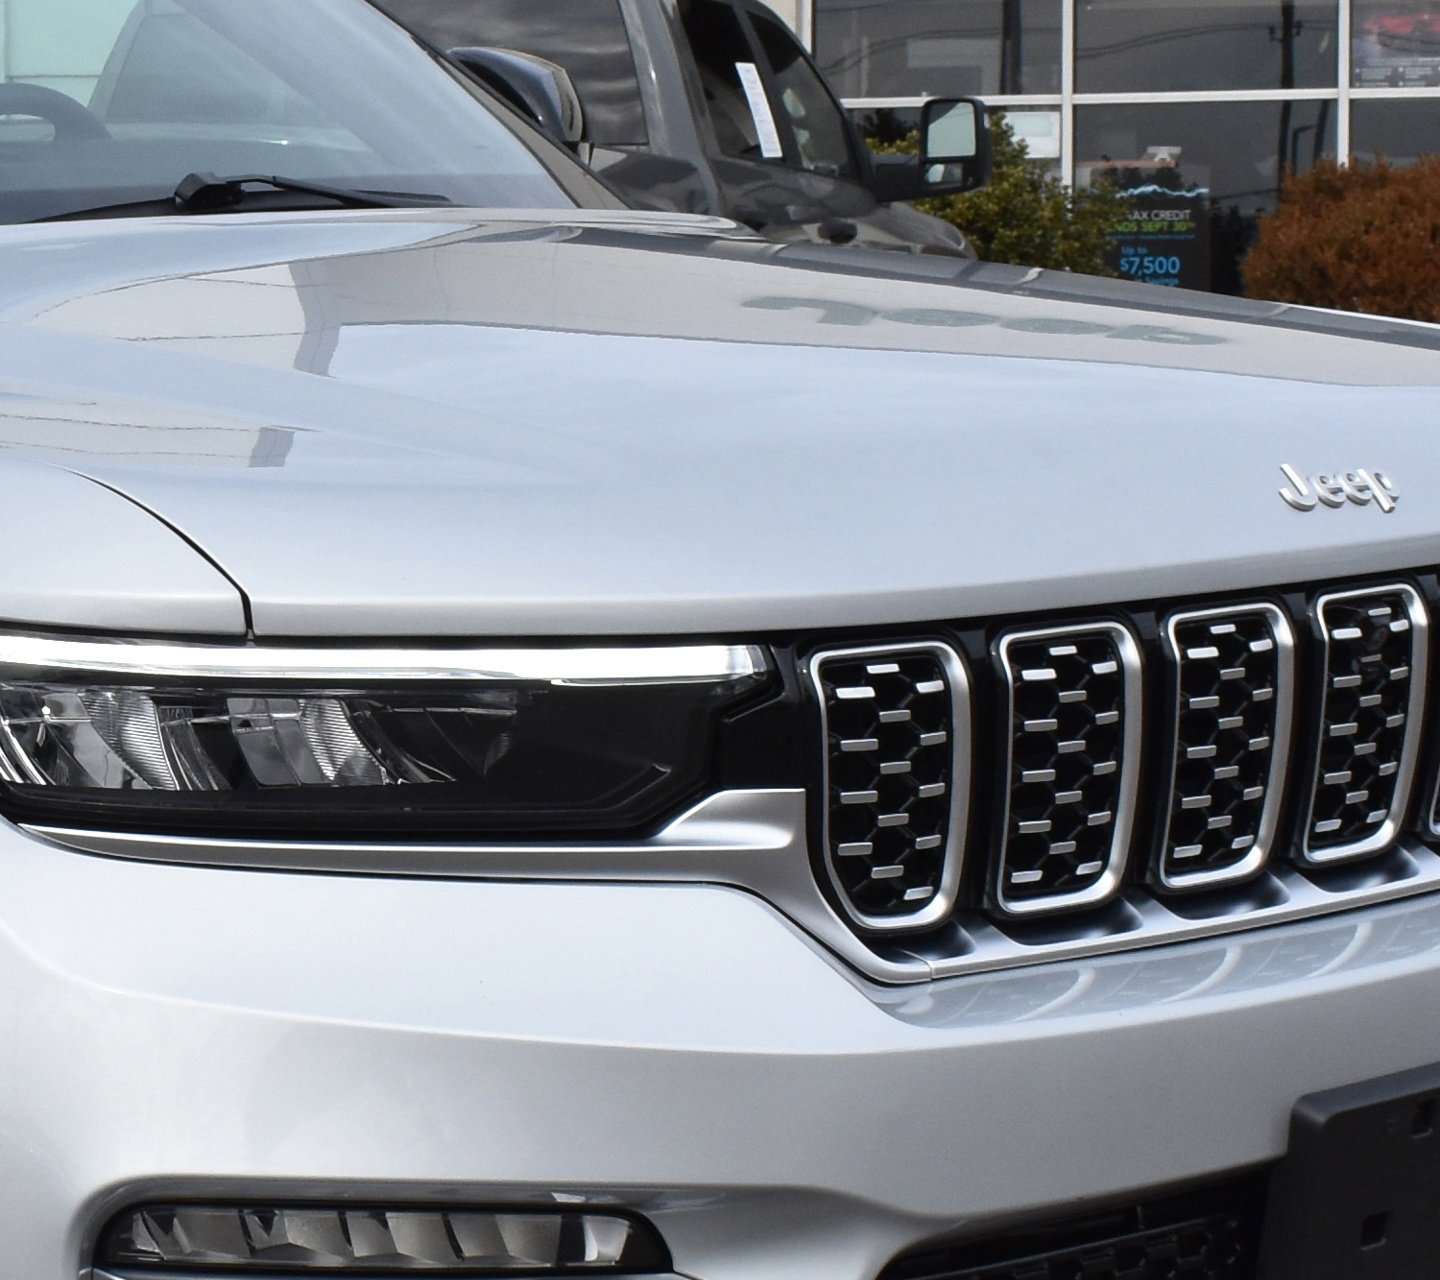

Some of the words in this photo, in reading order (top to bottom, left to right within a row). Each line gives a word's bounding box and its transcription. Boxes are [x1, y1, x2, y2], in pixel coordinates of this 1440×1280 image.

[1151, 209, 1192, 221] CREDIT
[1141, 221, 1169, 232] SEPT
[1119, 256, 1181, 276] $7,500
[1278, 463, 1400, 513] Jeep
